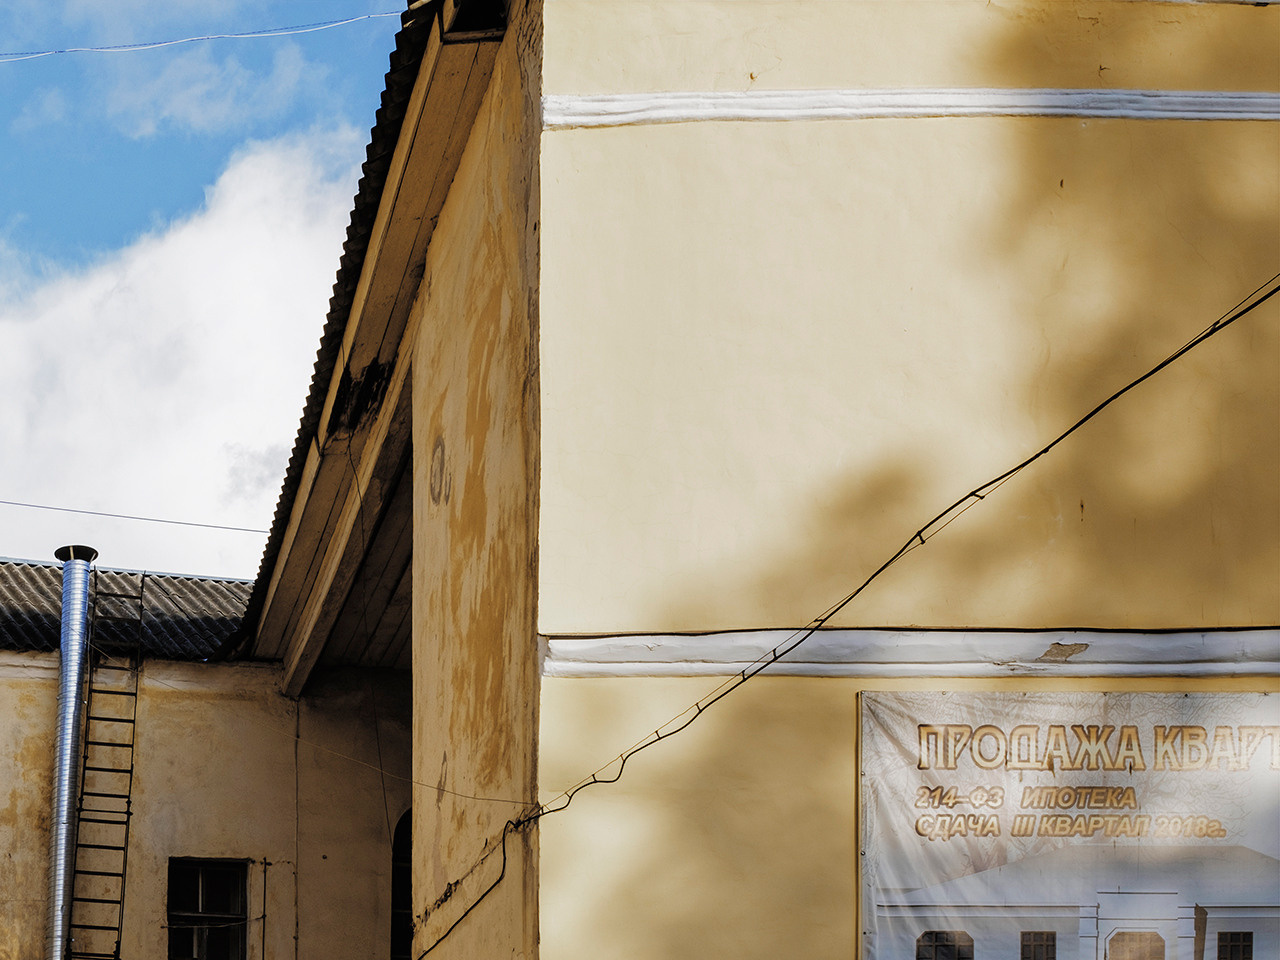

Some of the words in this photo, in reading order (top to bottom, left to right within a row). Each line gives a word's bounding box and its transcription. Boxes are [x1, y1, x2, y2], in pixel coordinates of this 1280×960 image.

[917, 724, 1147, 772] ПРОДАЖА
[1020, 785, 1138, 810] ИПОТЕКА
[915, 814, 1002, 841] СДАЧА
[1037, 814, 1153, 838] КВАРТАЛ
[1153, 814, 1228, 839] 2018г.
